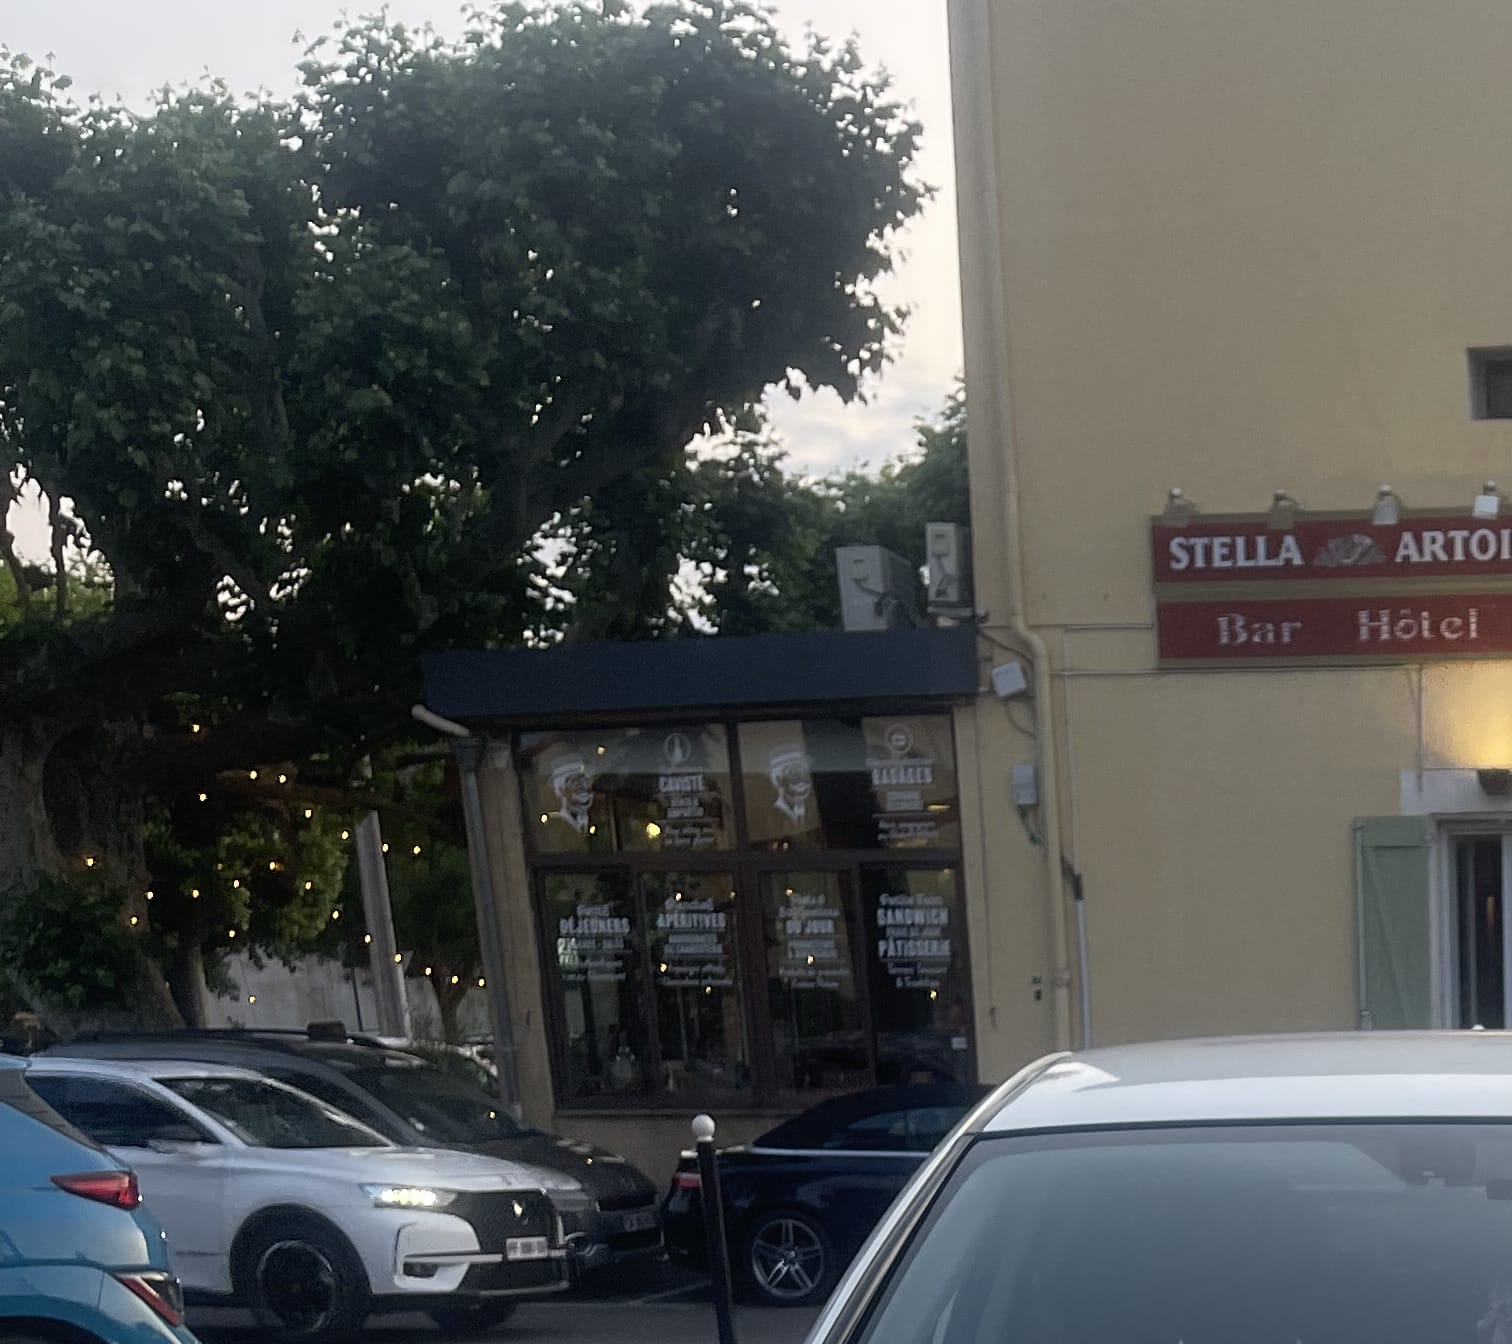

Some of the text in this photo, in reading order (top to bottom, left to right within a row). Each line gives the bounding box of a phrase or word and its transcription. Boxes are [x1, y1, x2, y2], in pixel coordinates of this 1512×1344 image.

[1169, 535, 1305, 570] STELLA
[1217, 607, 1481, 645] Bar Hôtel
